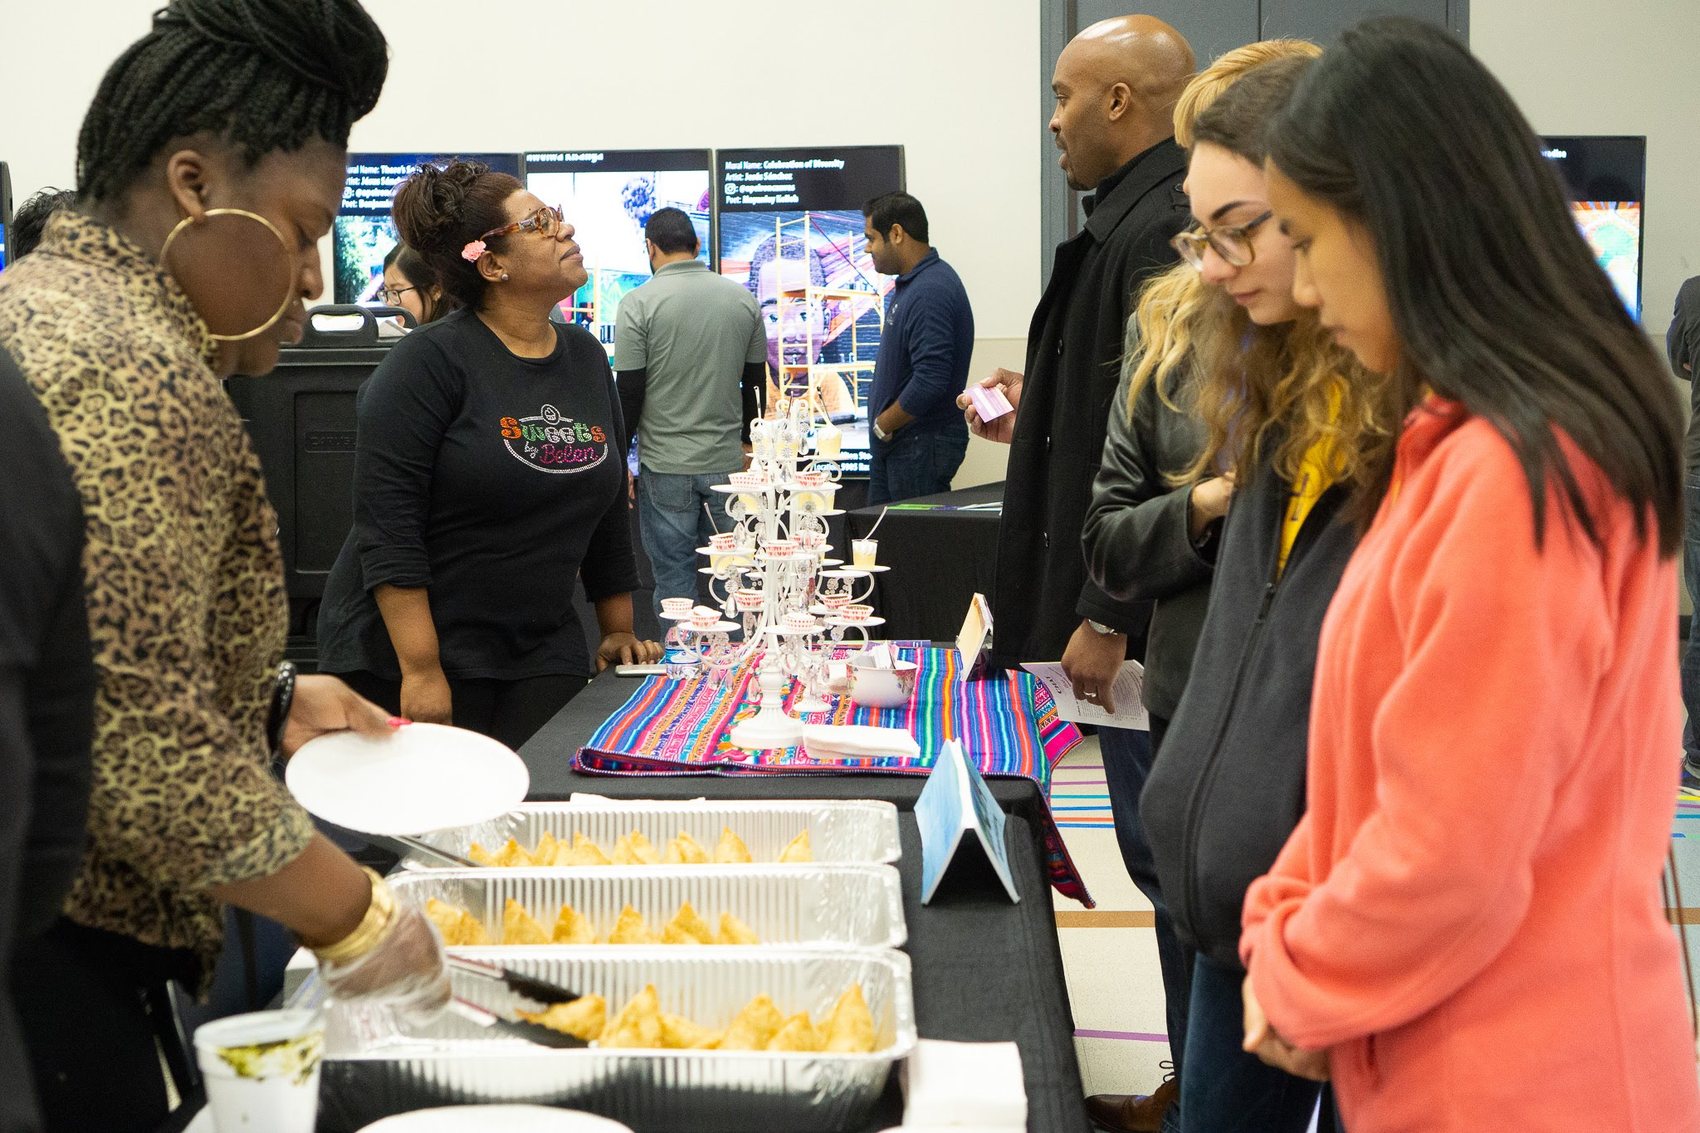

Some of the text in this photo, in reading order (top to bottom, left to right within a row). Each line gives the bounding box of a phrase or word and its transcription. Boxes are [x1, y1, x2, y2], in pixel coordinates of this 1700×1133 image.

[346, 165, 359, 174] ural
[725, 159, 845, 170] Mural Name: Celebration of Diversity
[725, 172, 744, 181] Artist:
[500, 416, 606, 444] Sweets
[524, 441, 538, 459] by
